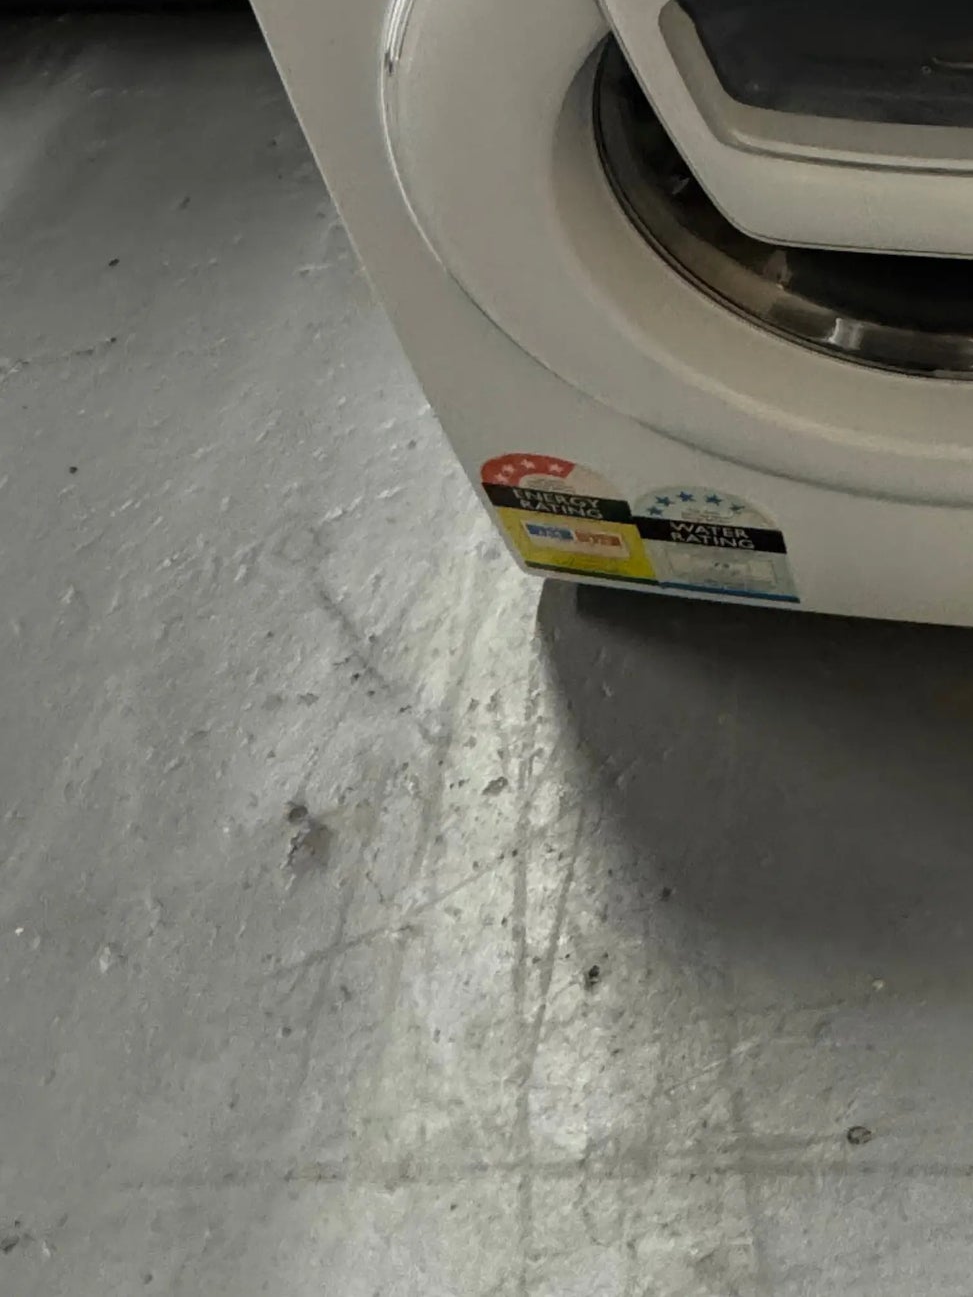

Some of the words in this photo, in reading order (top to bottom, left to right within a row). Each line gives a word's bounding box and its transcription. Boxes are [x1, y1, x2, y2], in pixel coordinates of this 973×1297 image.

[512, 487, 600, 509] ENERGY
[519, 499, 604, 519] RATING
[669, 521, 750, 539] WATER
[671, 531, 755, 550] RATING
